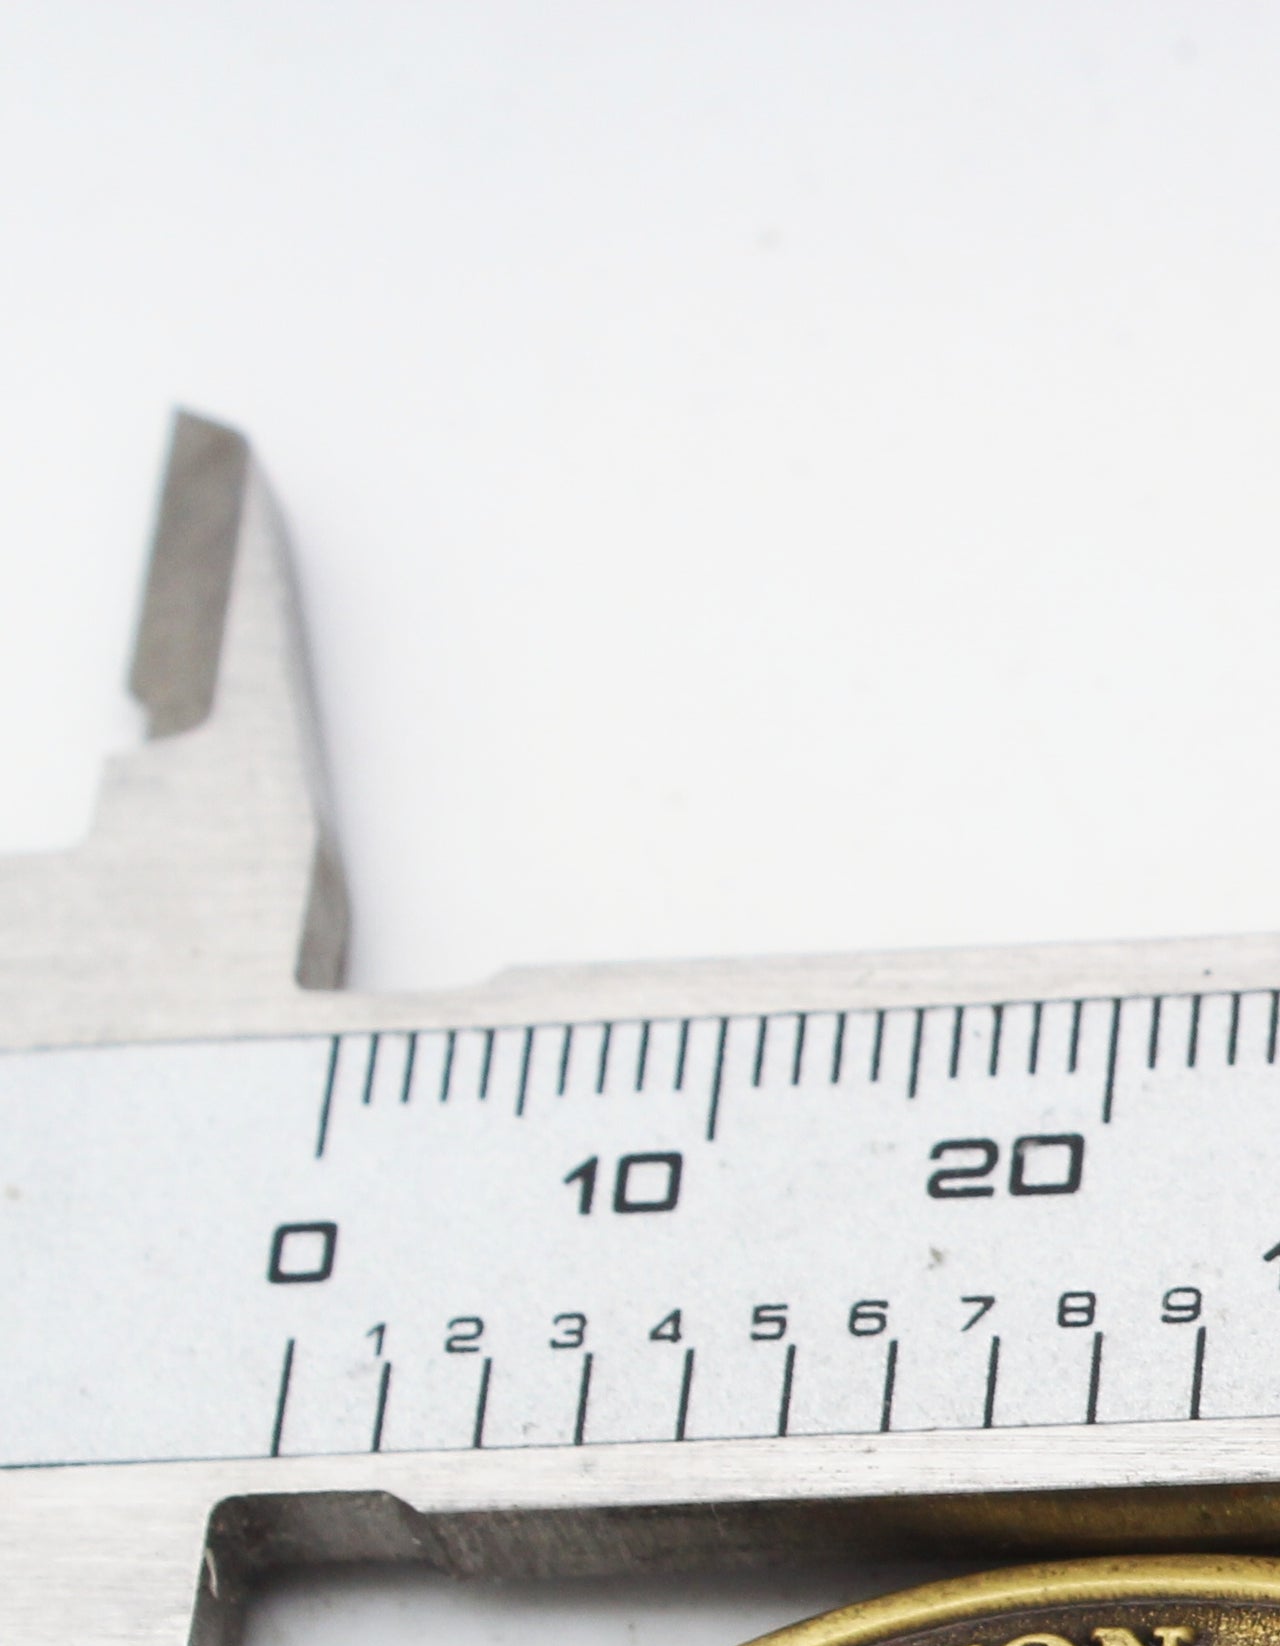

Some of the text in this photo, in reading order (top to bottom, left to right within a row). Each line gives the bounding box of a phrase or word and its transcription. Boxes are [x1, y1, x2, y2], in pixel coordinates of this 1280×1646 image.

[267, 1222, 338, 1284] 0
[563, 1151, 683, 1215] 10
[926, 1133, 1085, 1199] 20
[364, 1323, 389, 1356] 1
[444, 1317, 485, 1354] 2
[549, 1313, 588, 1350] 3
[648, 1309, 684, 1344] 4
[750, 1303, 789, 1341] 5
[848, 1300, 889, 1337] 6
[959, 1296, 996, 1332] 7
[1057, 1290, 1097, 1329] 8
[1161, 1285, 1203, 1324] 9
